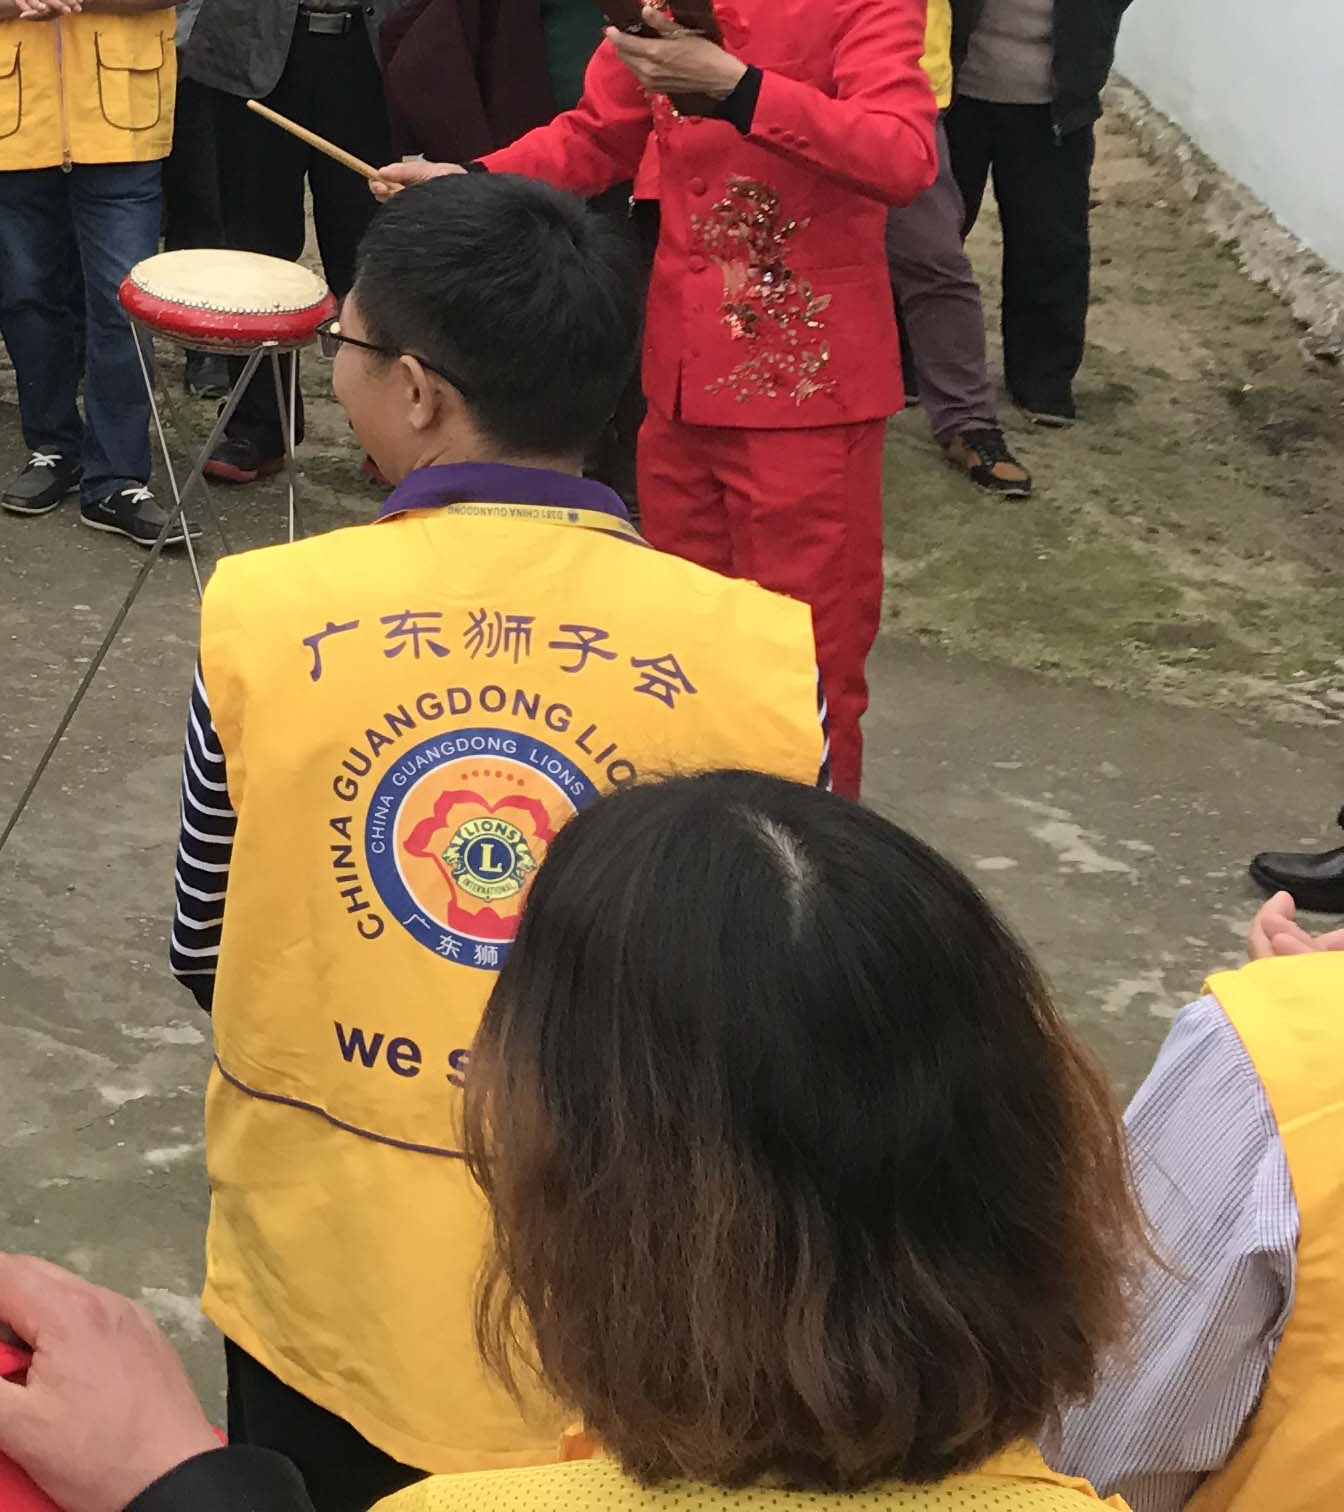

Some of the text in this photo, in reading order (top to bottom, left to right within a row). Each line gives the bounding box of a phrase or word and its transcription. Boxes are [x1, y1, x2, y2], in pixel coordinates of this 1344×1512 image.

[301, 607, 698, 709] 广东狮子会
[330, 684, 638, 940] CHINA GUANGDONG LIO
[370, 736, 586, 854] CHINA GUANGDONG LIONS
[463, 820, 518, 842] LIONS
[478, 843, 502, 873] L
[403, 913, 500, 967] 广东狮
[334, 1019, 422, 1078] we
